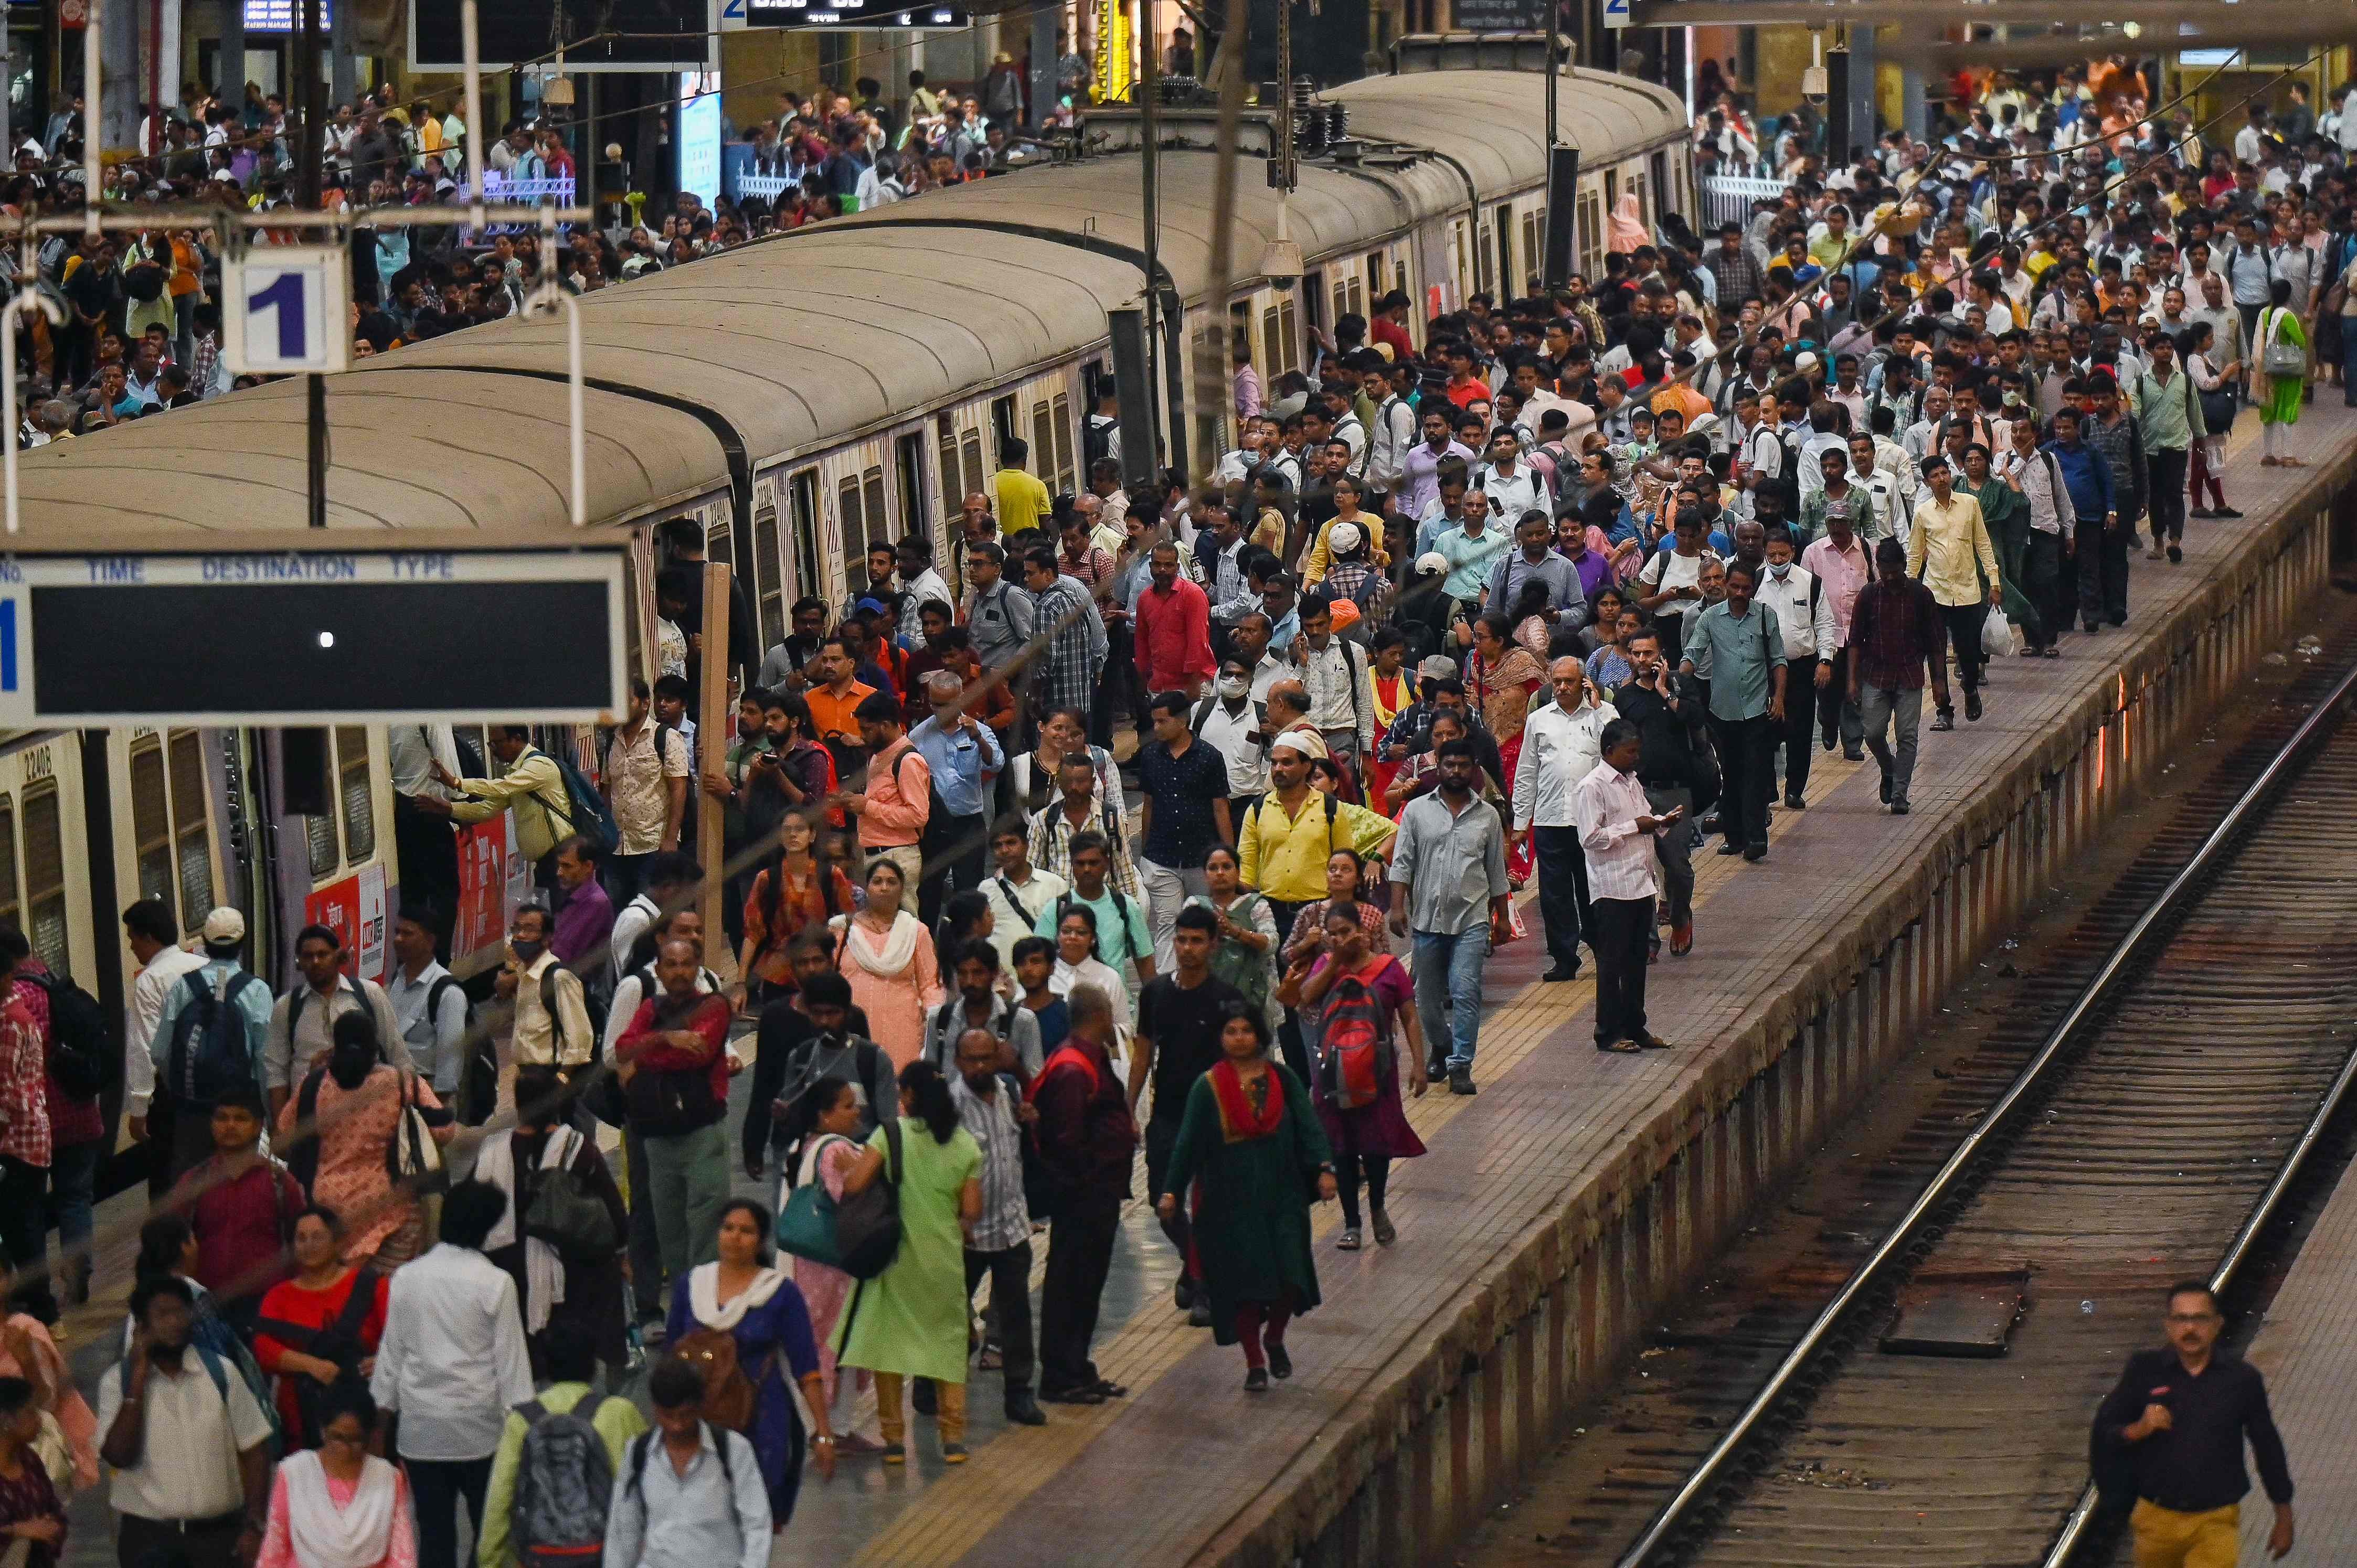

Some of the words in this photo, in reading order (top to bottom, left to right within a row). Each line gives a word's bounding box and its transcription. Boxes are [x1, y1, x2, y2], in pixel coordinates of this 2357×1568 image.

[249, 273, 305, 358] 1
[87, 559, 144, 582] TIME
[202, 557, 356, 580] DESTINATION
[390, 555, 454, 579] TYPE
[0, 599, 17, 691] 1
